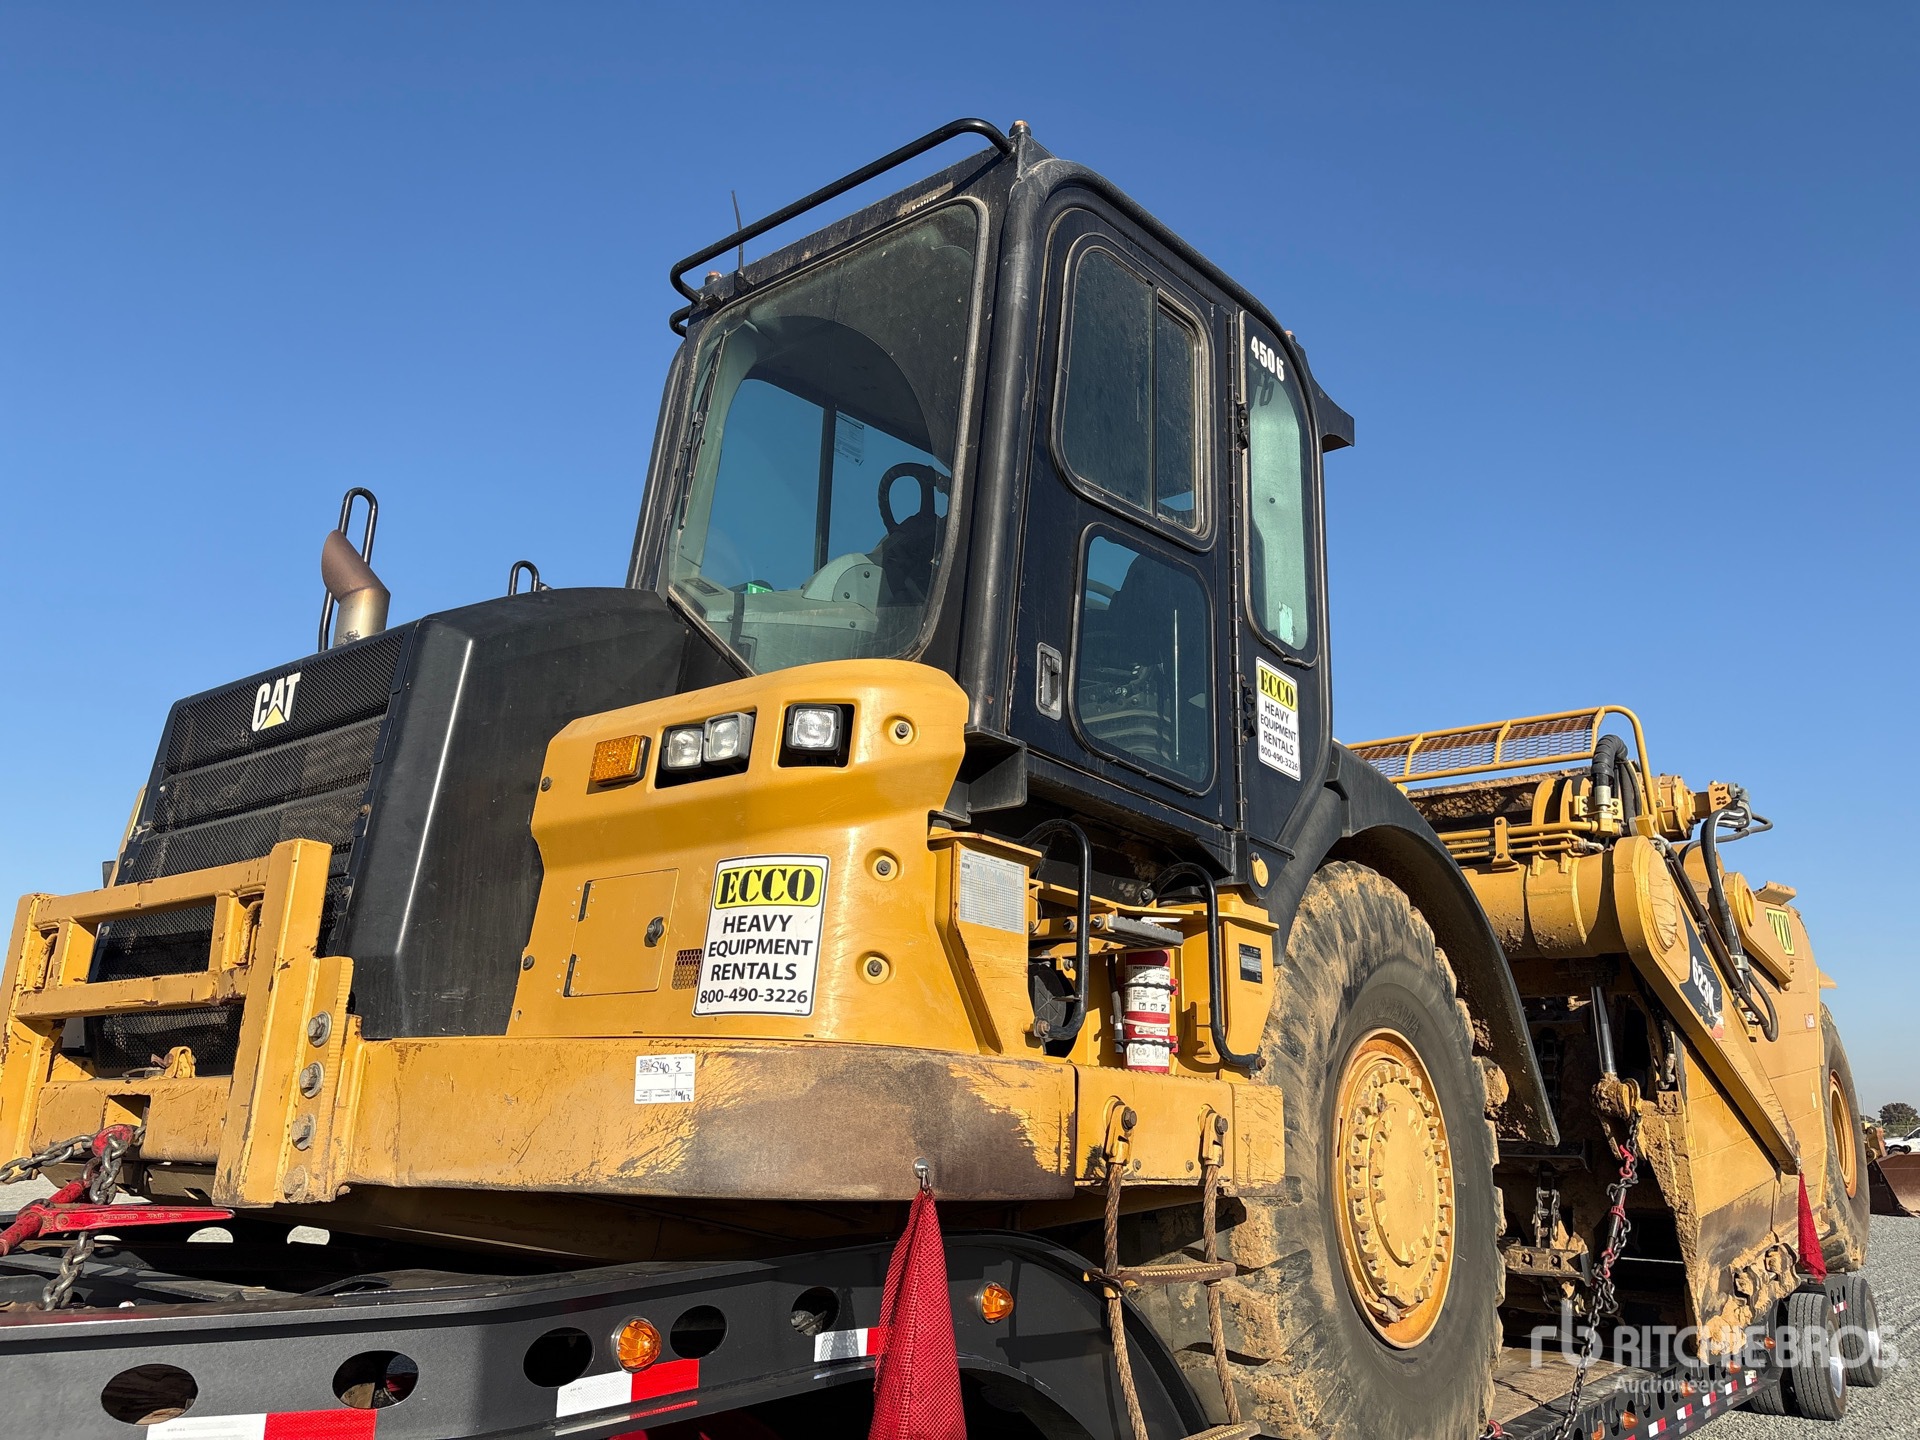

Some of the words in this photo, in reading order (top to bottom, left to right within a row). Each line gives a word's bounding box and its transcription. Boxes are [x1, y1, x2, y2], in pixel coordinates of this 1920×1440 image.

[1251, 336, 1285, 382] 4506
[1260, 669, 1294, 707] ECCO
[251, 671, 301, 732] CAT
[1264, 701, 1290, 725] HEAVY
[1260, 714, 1297, 742] EQUIPMENT
[1263, 730, 1294, 756] RENTALS
[1260, 745, 1299, 771] 800-490-3226
[718, 868, 815, 905] ECCO
[722, 914, 793, 934] HEAVY
[708, 938, 813, 958] EQUIPMENT
[710, 962, 797, 981] RENTALS
[699, 987, 808, 1004] 800-490-3226
